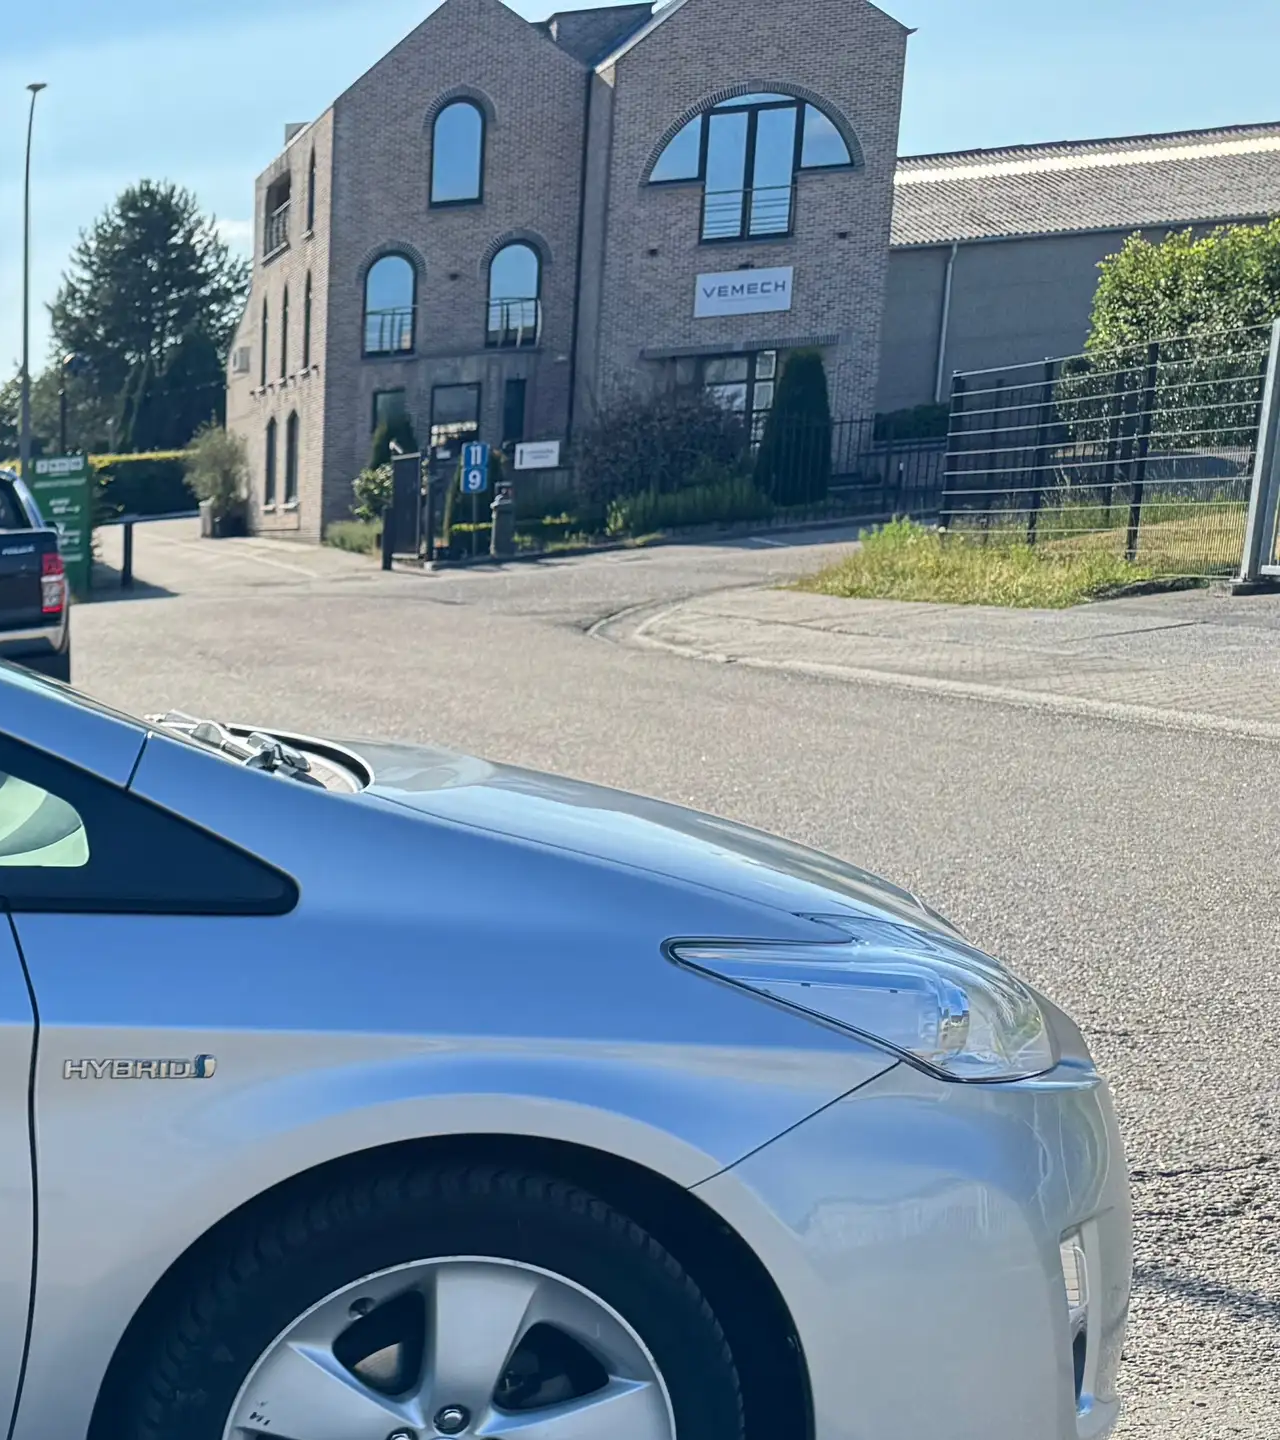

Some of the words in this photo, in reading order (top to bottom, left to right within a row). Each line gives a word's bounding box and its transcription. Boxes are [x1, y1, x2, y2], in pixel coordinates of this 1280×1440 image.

[702, 280, 786, 298] VEMECH
[470, 445, 482, 465] 11
[468, 469, 481, 490] 9
[63, 1058, 191, 1079] HYBRID
